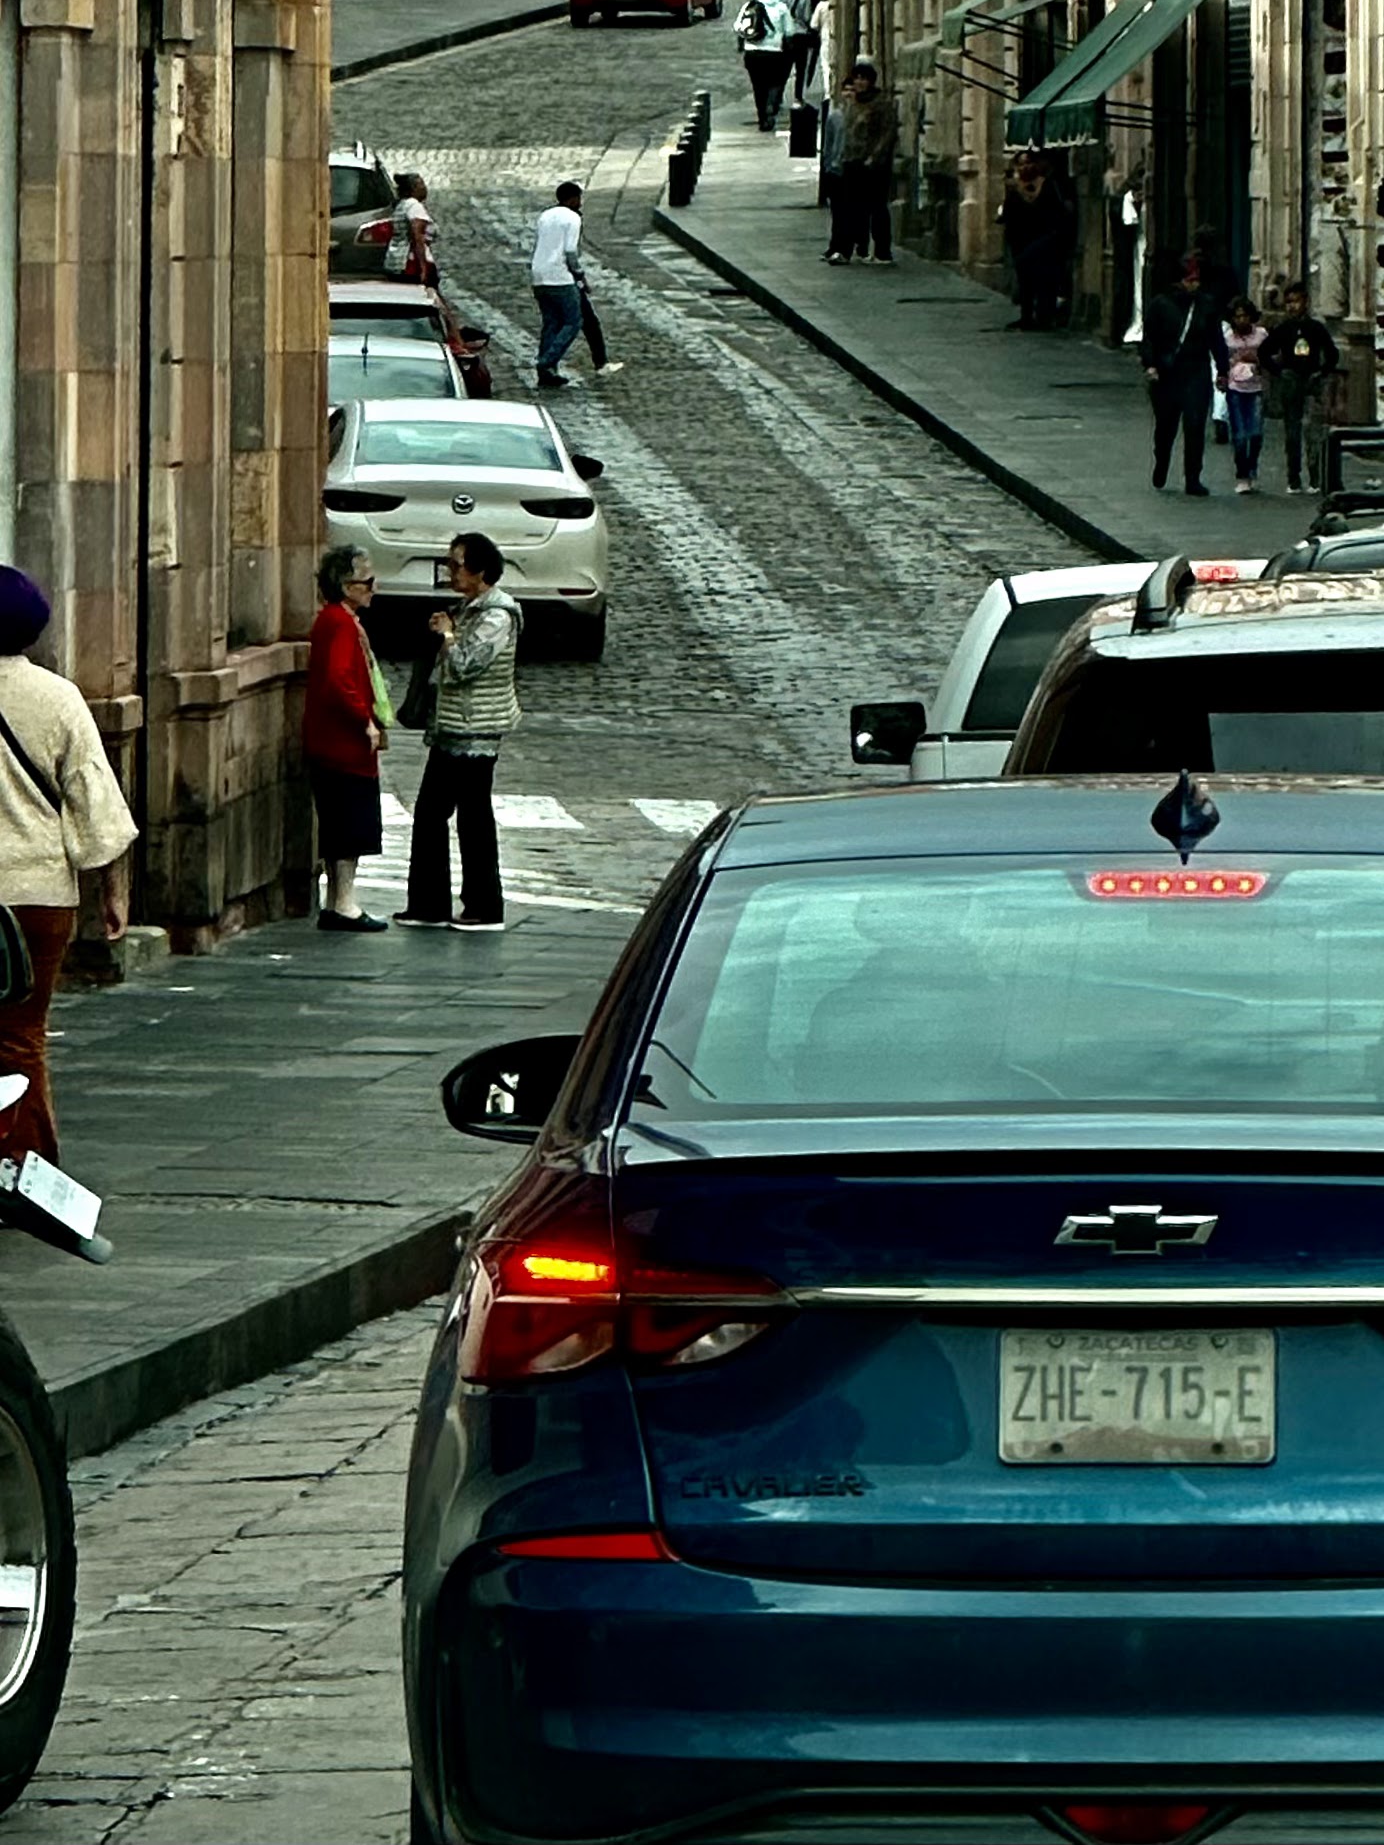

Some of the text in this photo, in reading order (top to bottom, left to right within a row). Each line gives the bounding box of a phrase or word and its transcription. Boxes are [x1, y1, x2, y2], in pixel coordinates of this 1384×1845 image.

[1077, 1336, 1199, 1352] ZACATECAS
[1010, 1363, 1263, 1423] ZHE-715-E
[680, 1475, 866, 1499] CAVALIER
